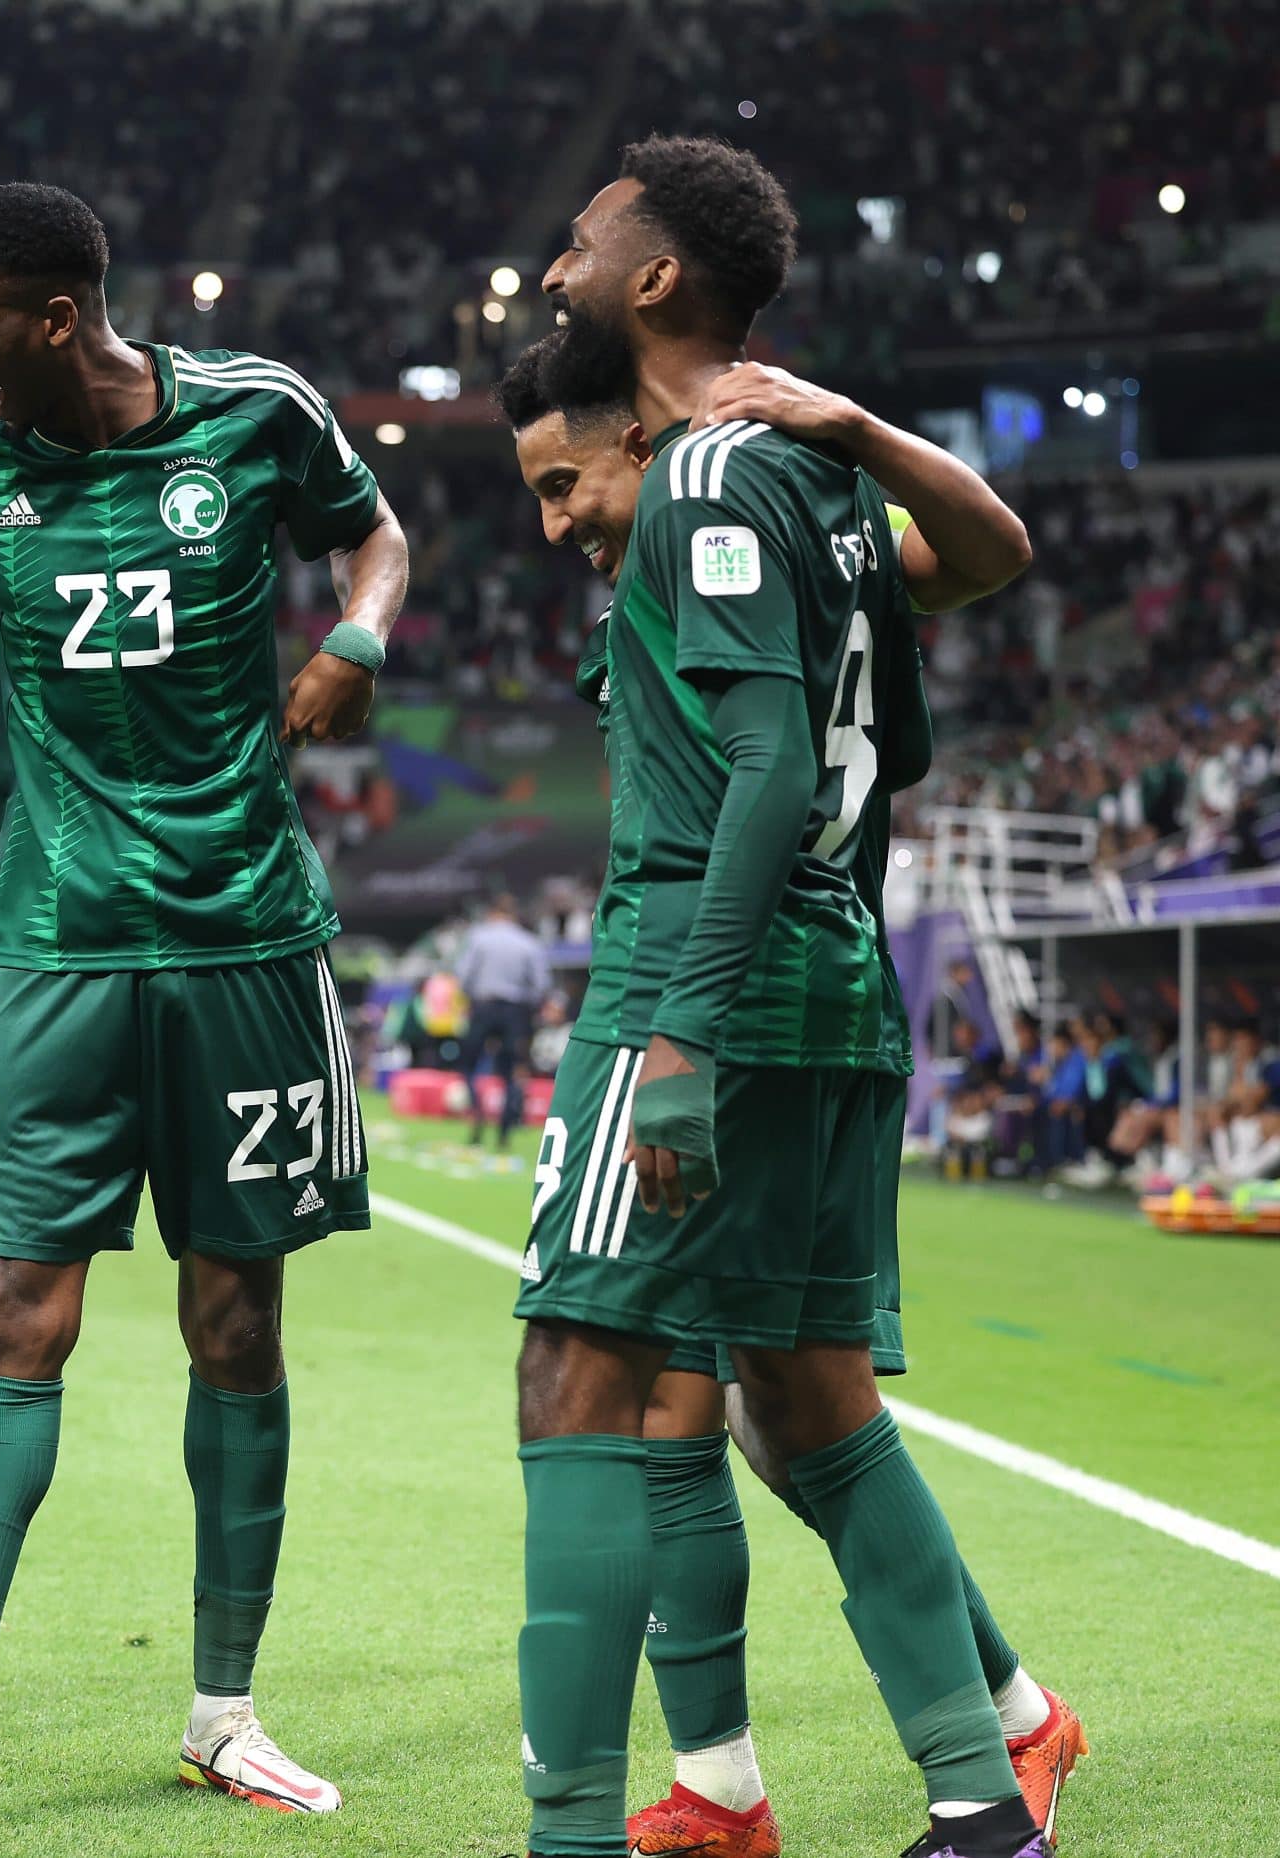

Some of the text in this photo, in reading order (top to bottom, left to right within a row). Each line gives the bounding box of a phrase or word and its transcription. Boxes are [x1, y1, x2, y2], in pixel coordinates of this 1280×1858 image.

[163, 456, 217, 472] السعودية
[705, 536, 731, 546] AFC
[179, 546, 216, 557] SAUDI
[705, 548, 750, 565] LIVE
[55, 569, 175, 669] 23
[227, 1078, 325, 1184] 23
[293, 1198, 325, 1217] adidas
